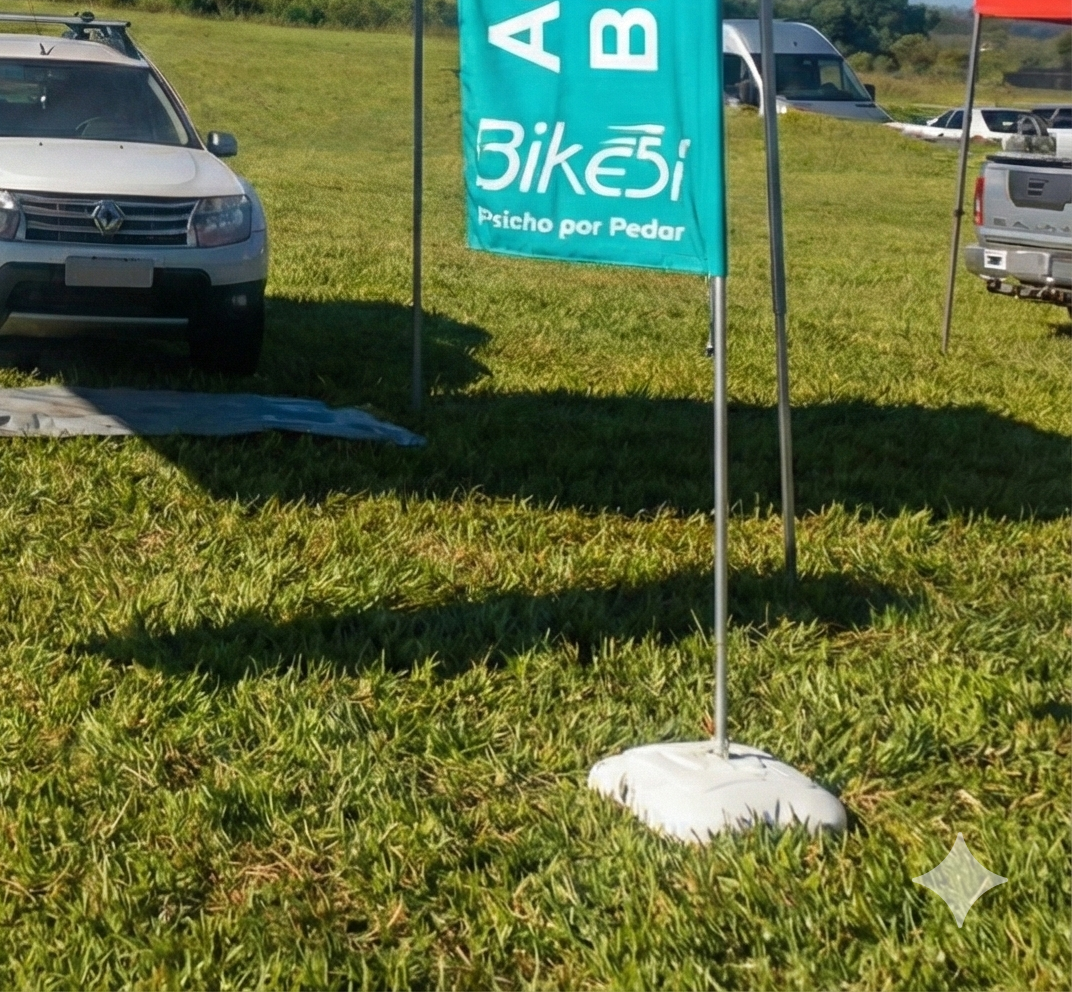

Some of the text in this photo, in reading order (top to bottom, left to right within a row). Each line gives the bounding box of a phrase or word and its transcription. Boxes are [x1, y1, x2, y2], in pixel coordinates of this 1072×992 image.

[478, 205, 686, 242] Psicho por Pedar
